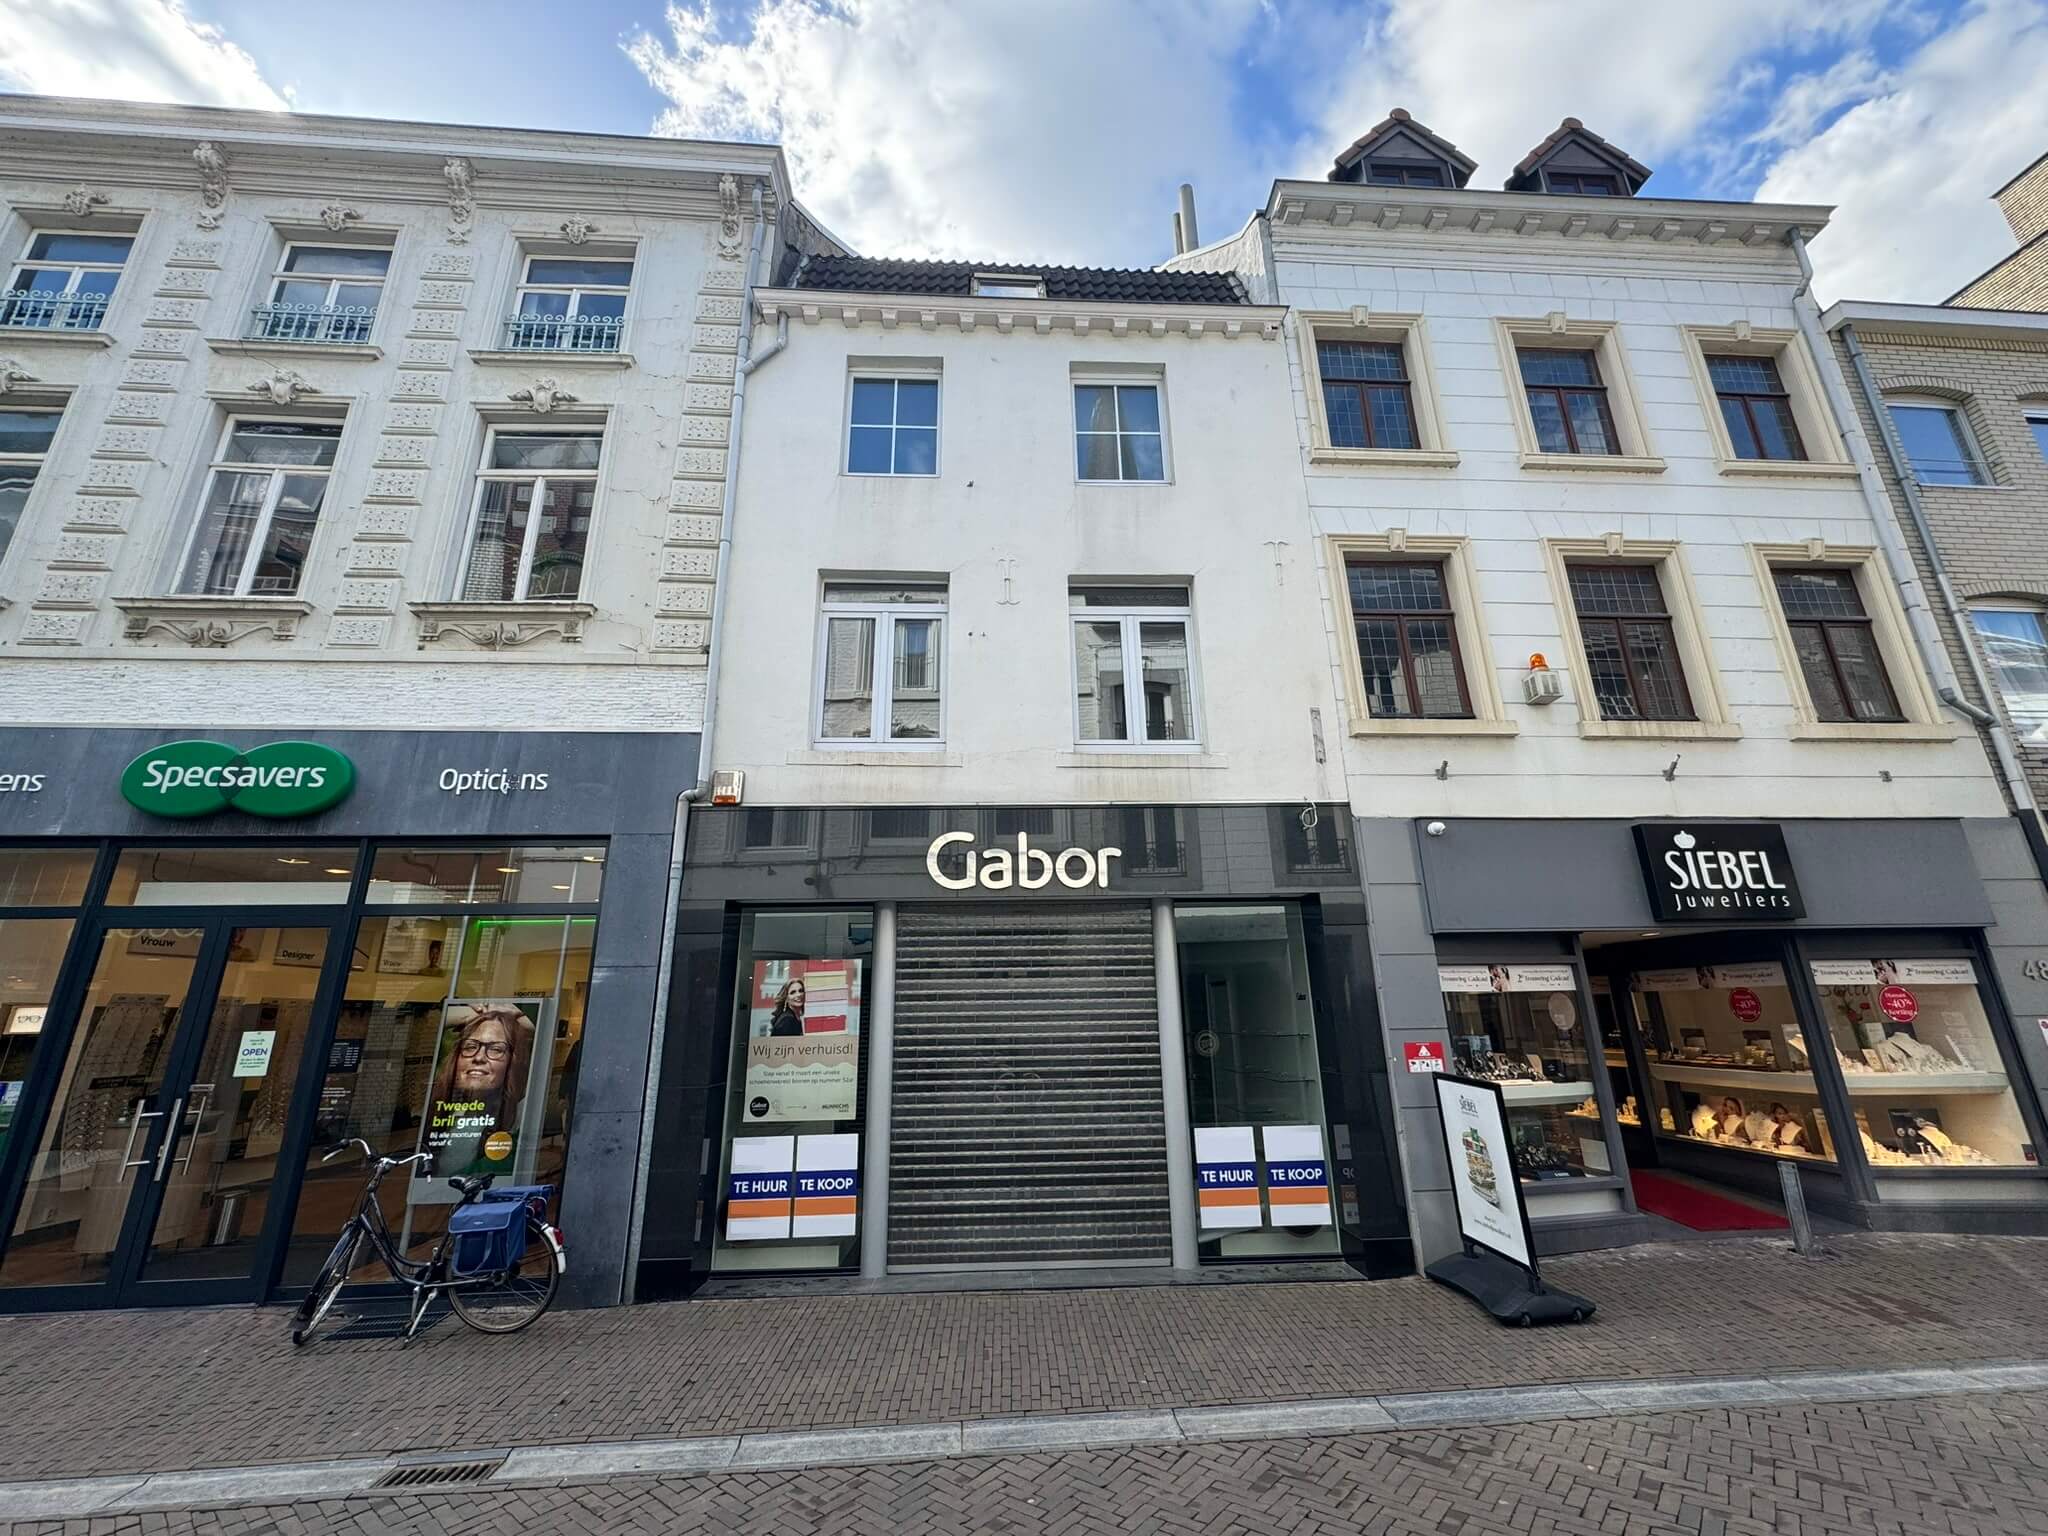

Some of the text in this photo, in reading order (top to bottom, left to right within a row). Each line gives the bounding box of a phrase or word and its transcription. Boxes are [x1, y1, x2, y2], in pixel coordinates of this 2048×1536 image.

[142, 759, 327, 794] Specsavers
[439, 767, 549, 796] Opticins
[926, 831, 1122, 890] Gabor
[1664, 850, 1787, 890] SIEBEL
[1674, 891, 1791, 912] Juweliers
[140, 935, 176, 949] Vrouw
[281, 949, 316, 961] Designer
[241, 1047, 268, 1057] OPEN
[752, 1043, 854, 1059] Wij zijn verhuisd!
[435, 1100, 486, 1112] Tweede
[432, 1114, 495, 1129] bril gratis
[1201, 1169, 1254, 1183] TE HUUR
[1270, 1167, 1323, 1181] TE KOOP
[733, 1179, 788, 1194] TE HUUR
[799, 1177, 854, 1191] TE KOOP
